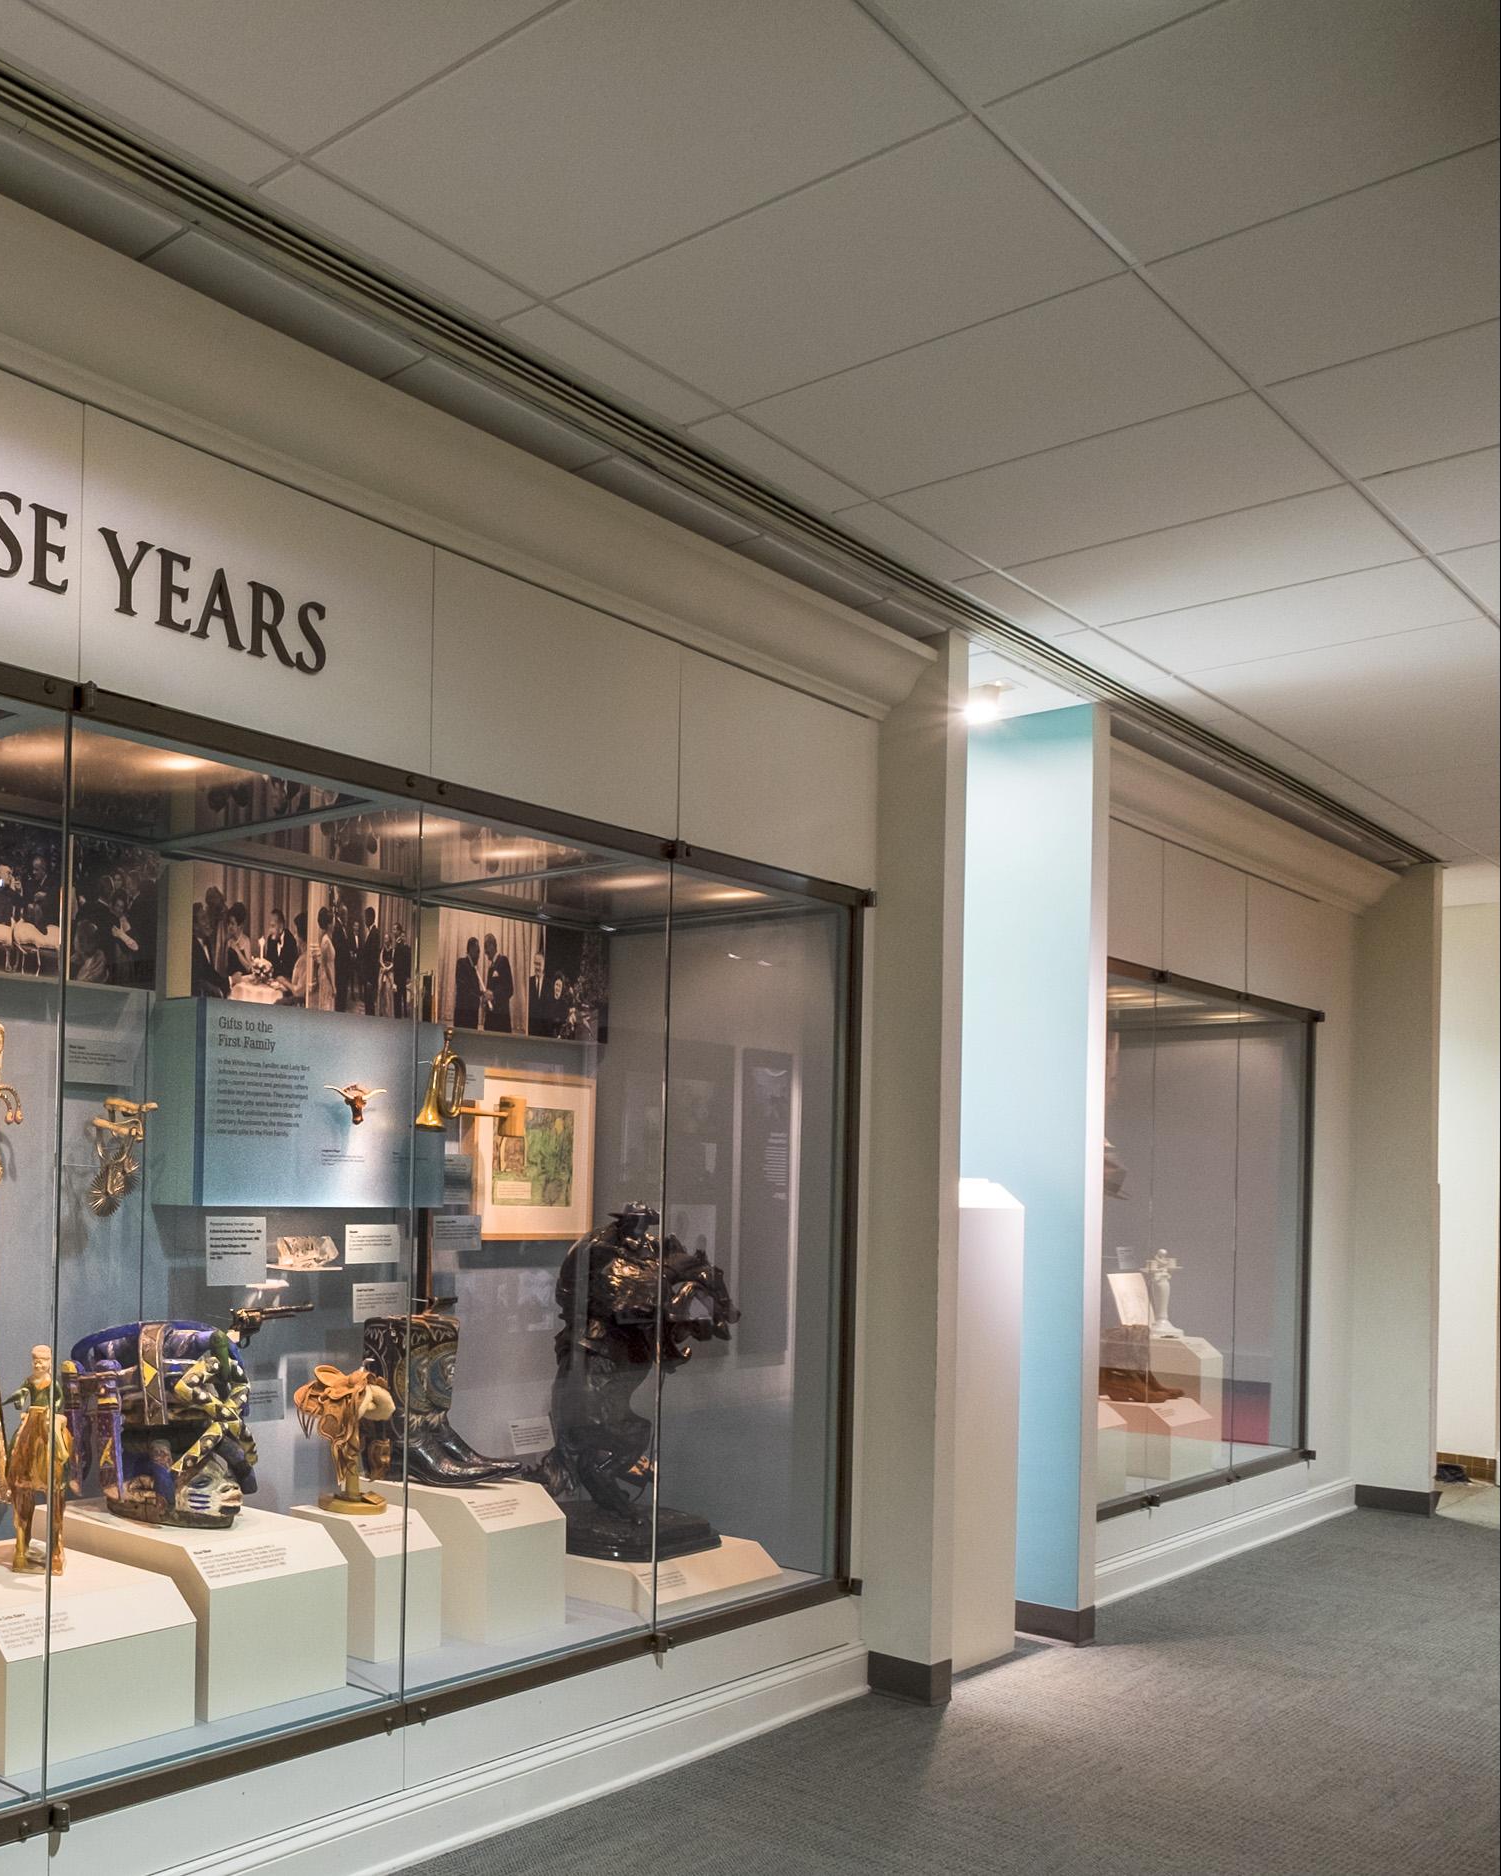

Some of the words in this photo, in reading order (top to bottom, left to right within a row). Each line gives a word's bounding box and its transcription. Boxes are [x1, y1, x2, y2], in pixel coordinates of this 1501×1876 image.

[98, 526, 327, 675] YEARS
[218, 1016, 243, 1031] Gifts
[245, 1020, 255, 1031] to
[257, 1020, 273, 1033] the
[218, 1034, 241, 1048] First
[243, 1036, 276, 1052] Family
